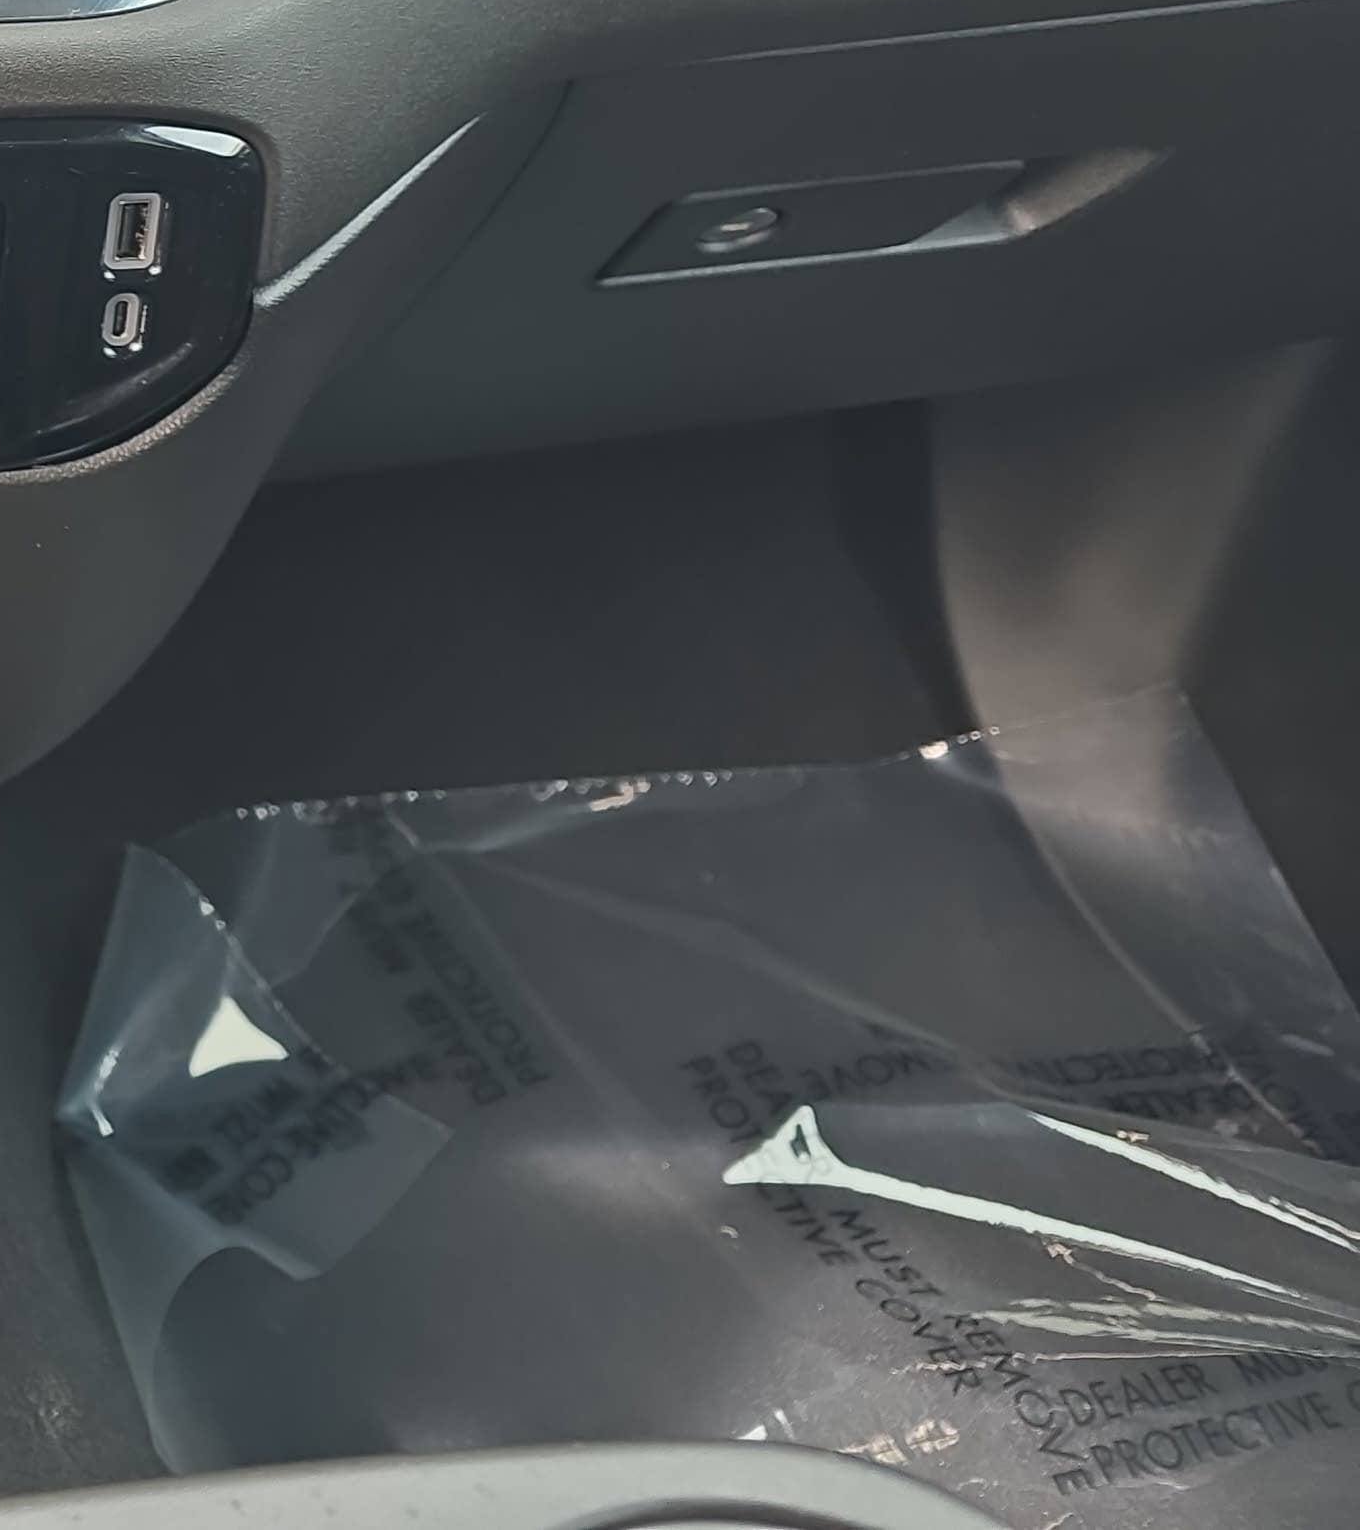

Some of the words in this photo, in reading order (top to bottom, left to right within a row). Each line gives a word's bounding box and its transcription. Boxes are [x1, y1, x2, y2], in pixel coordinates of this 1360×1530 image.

[829, 1209, 945, 1297] MUST
[854, 1277, 982, 1398] COVER
[1060, 1362, 1221, 1428] DEALER
[1089, 1390, 1345, 1486] PROTECTIVE
